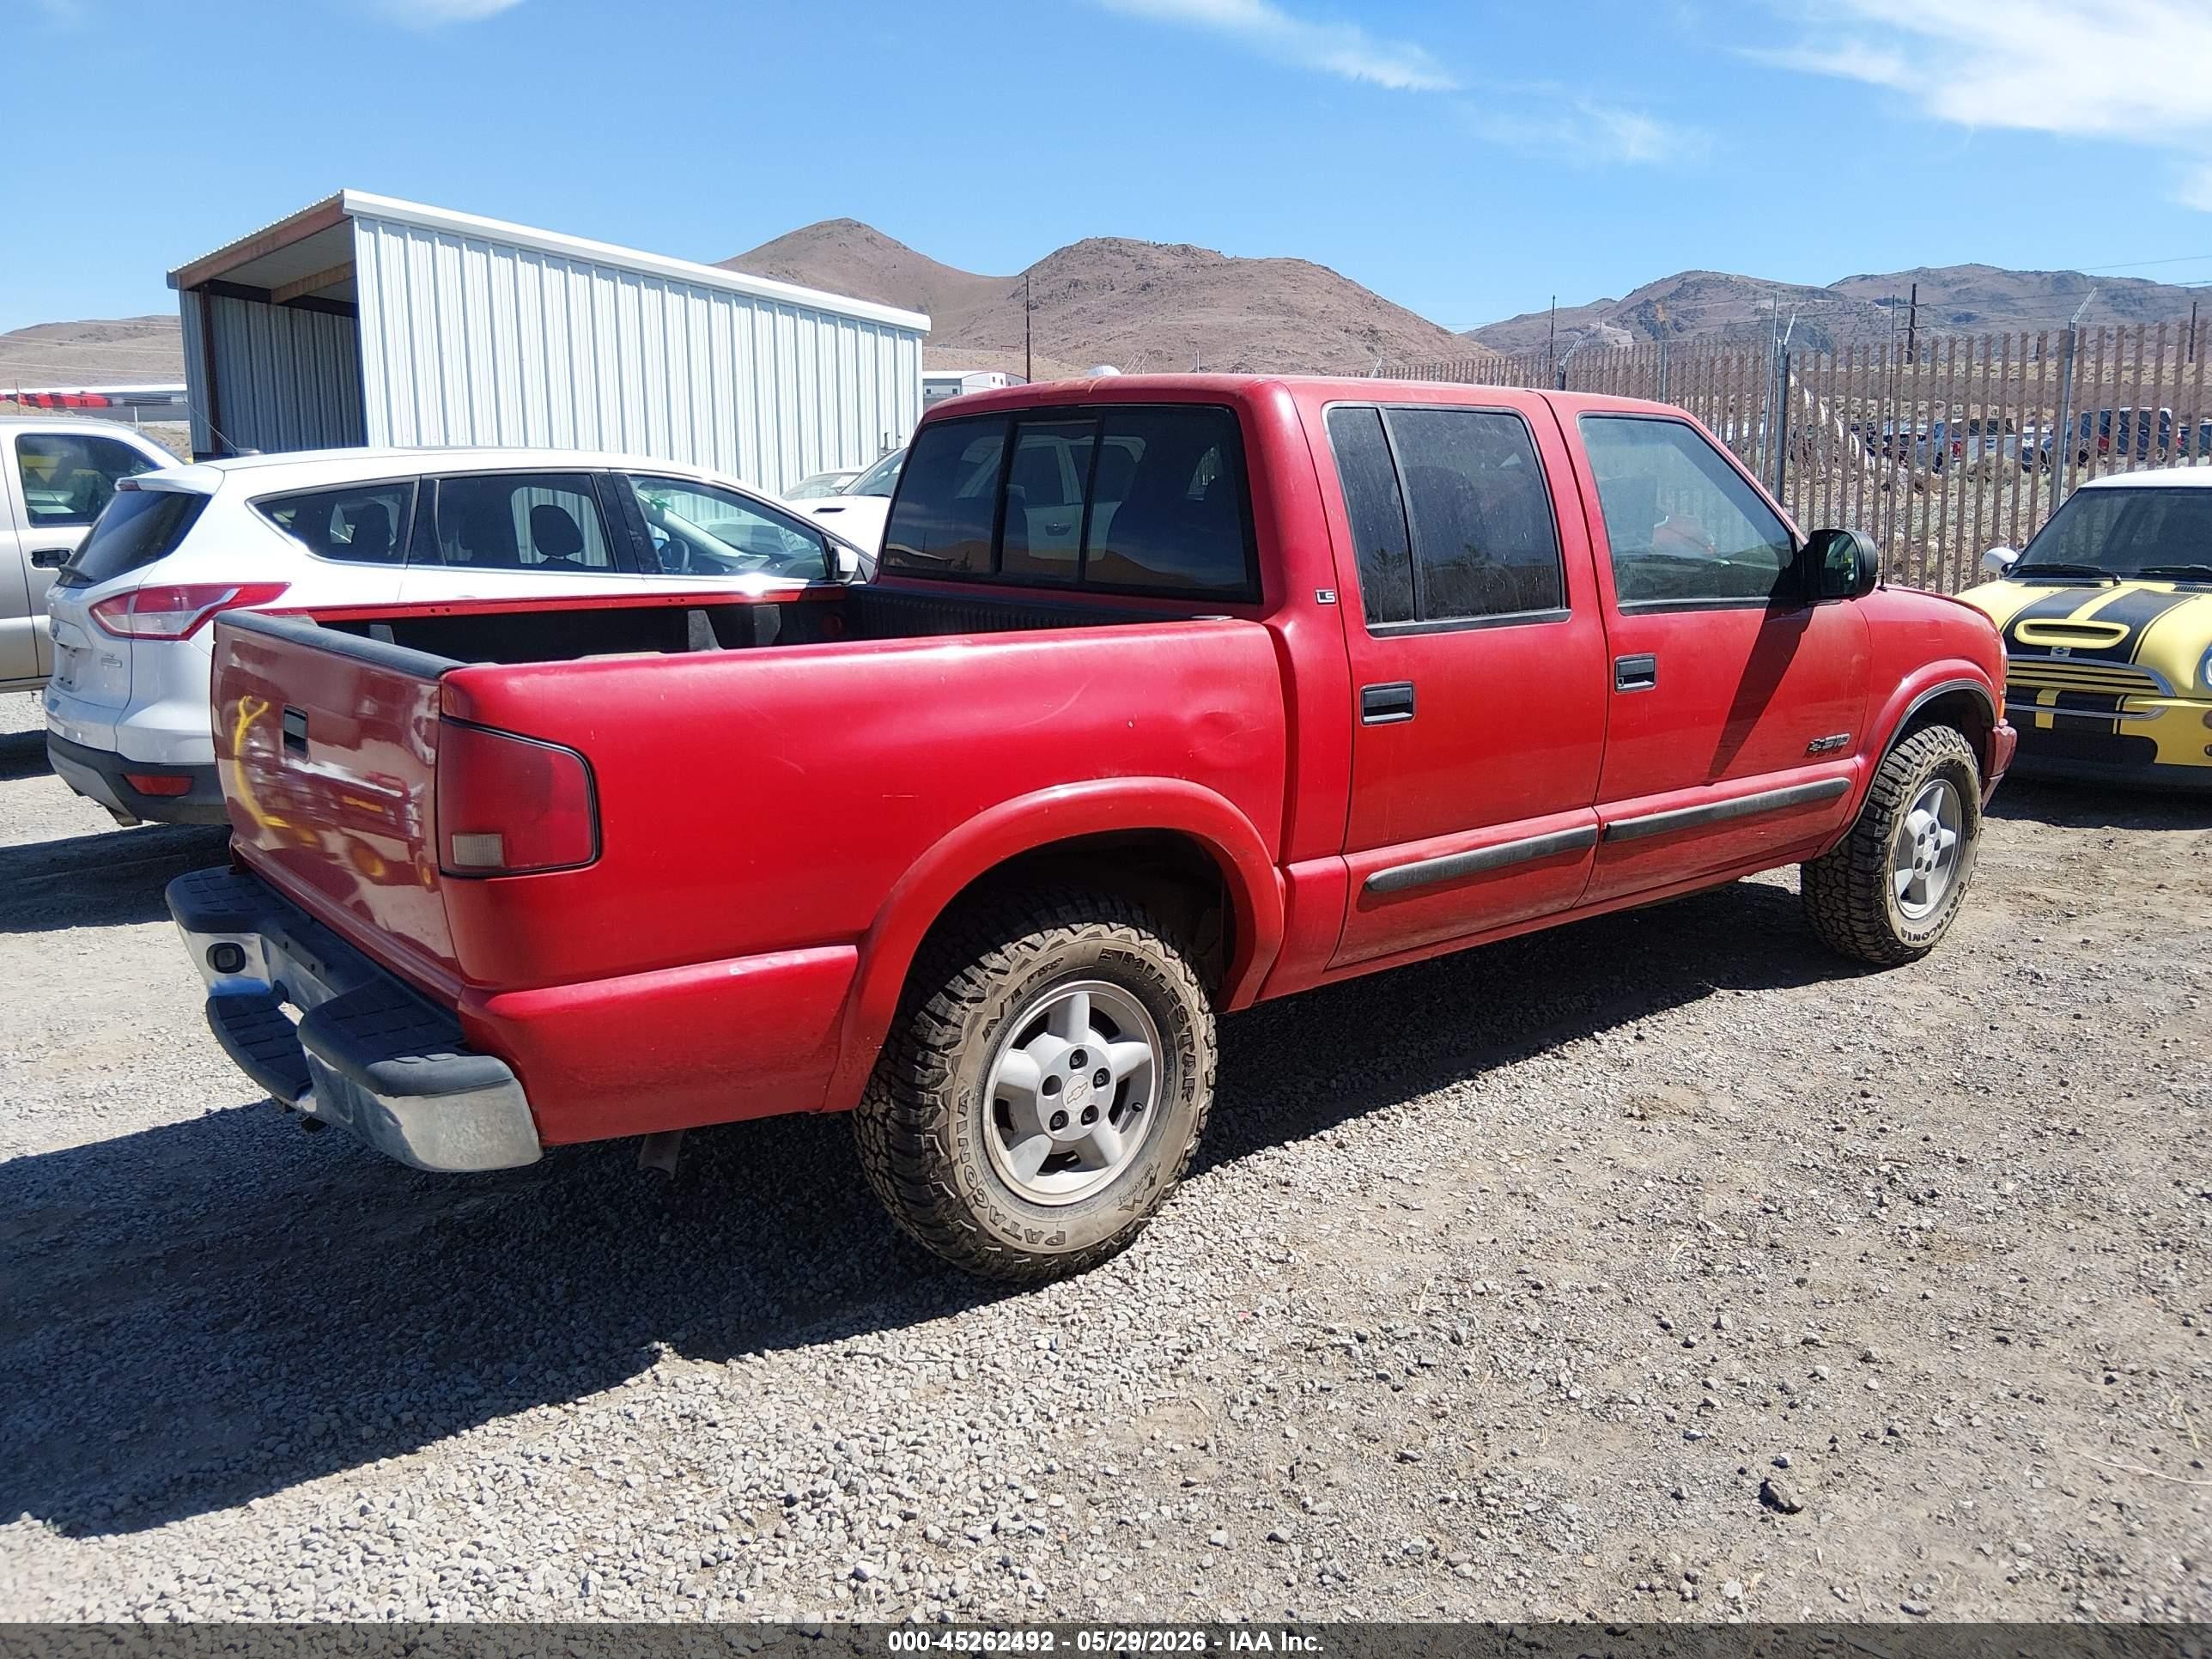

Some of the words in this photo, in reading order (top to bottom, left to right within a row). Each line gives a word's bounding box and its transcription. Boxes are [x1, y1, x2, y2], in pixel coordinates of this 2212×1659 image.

[1316, 592, 1336, 603] LS
[1121, 951, 1197, 1103] MILESTAR
[957, 1089, 1066, 1246] PATAGONIA
